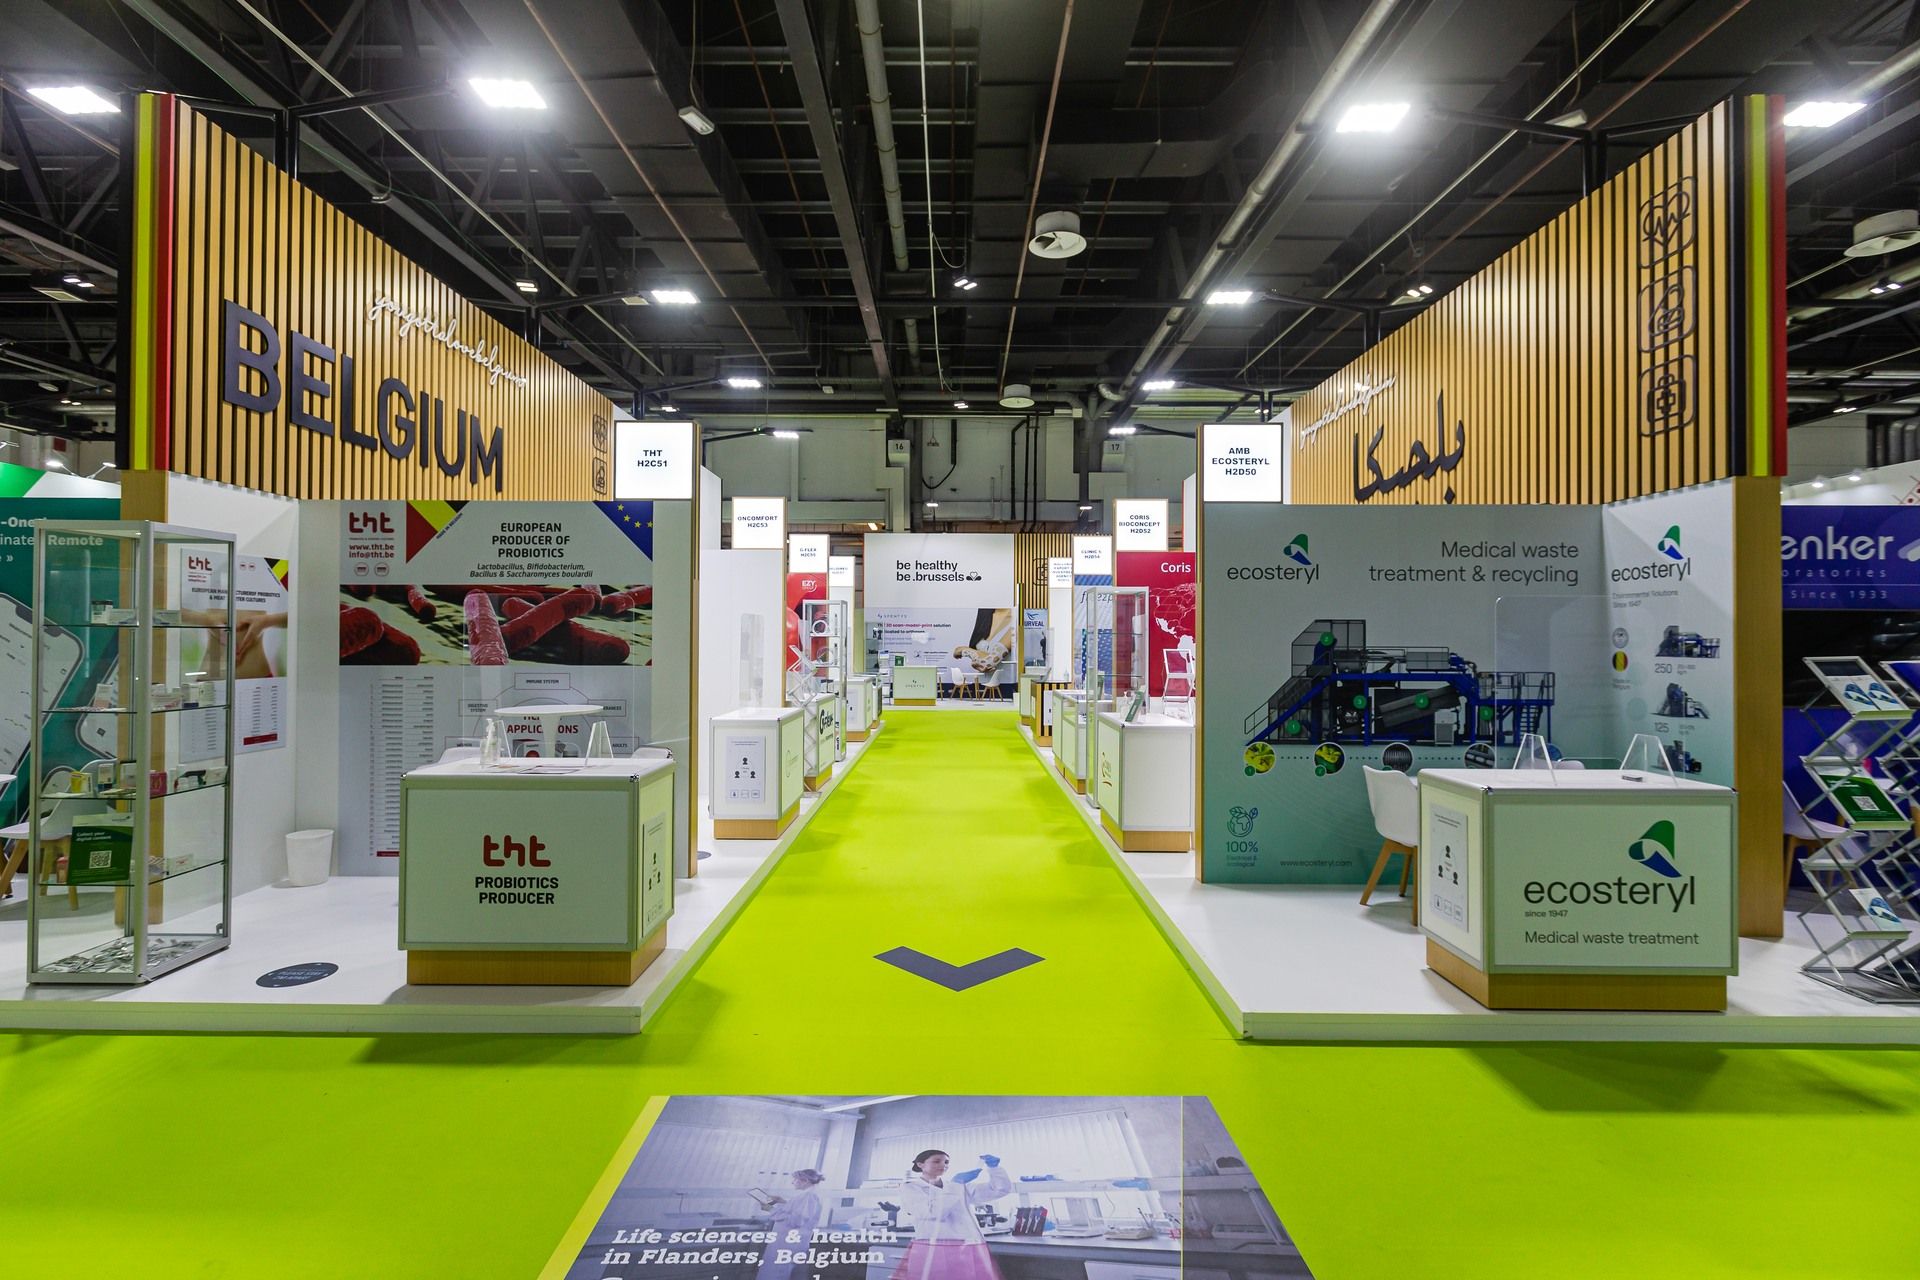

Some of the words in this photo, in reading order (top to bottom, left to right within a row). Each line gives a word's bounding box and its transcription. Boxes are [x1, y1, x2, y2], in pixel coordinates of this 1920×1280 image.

[223, 300, 503, 493] BELGIUM
[1111, 443, 1120, 451] 17
[1228, 447, 1250, 455] AMB
[643, 449, 663, 457] THT
[1211, 457, 1270, 465] ECOSTERYL
[1225, 468, 1257, 476] H2D50
[349, 512, 395, 533] tht
[500, 522, 562, 533] EUROPEAN
[48, 534, 104, 546] Remote
[492, 535, 553, 545] PRODUCER
[555, 535, 571, 545] OF
[1780, 525, 1895, 561] enker
[349, 543, 395, 551] www.tht.be
[1440, 541, 1517, 559] Medical
[1521, 545, 1580, 559] waste
[349, 551, 395, 559] info@tht.be
[498, 548, 565, 558] PROBIOTICS
[188, 556, 213, 571] tht
[477, 562, 525, 571] Lactobacillus,
[896, 560, 911, 570] be
[915, 560, 958, 572] healthy
[1160, 562, 1192, 573] Coris
[469, 570, 498, 578] Bacillus
[506, 570, 560, 579] Saccharomyces
[561, 570, 593, 578] boulardii
[1226, 563, 1320, 585] ecosteryl
[1611, 556, 1692, 583] ecosteryl
[1781, 569, 1887, 578] oratories
[1368, 565, 1466, 583] treatment
[1472, 565, 1487, 583] &
[1491, 564, 1580, 587] recycling
[1790, 590, 1837, 599] Since
[1848, 590, 1888, 599] 1933
[1654, 663, 1673, 674] 250
[507, 724, 579, 734] APPLICONS
[1655, 722, 1670, 733] 125
[483, 834, 552, 867] tht
[1226, 841, 1259, 853] 100%
[474, 876, 559, 889] PROBIOTICS
[478, 892, 555, 904] PRODUCER
[1523, 875, 1696, 913] ecosteryl
[1524, 910, 1547, 918] since
[1548, 909, 1569, 918] 1947
[1525, 931, 1579, 945] Medical
[1582, 932, 1625, 945] waste
[1628, 932, 1700, 945] treatment
[611, 1229, 663, 1245] Life
[668, 1229, 778, 1245] sciences
[784, 1229, 802, 1244] &
[810, 1228, 899, 1244] health
[600, 1248, 631, 1265] in
[637, 1248, 765, 1268] Flanders,
[773, 1248, 886, 1269] Belgium
